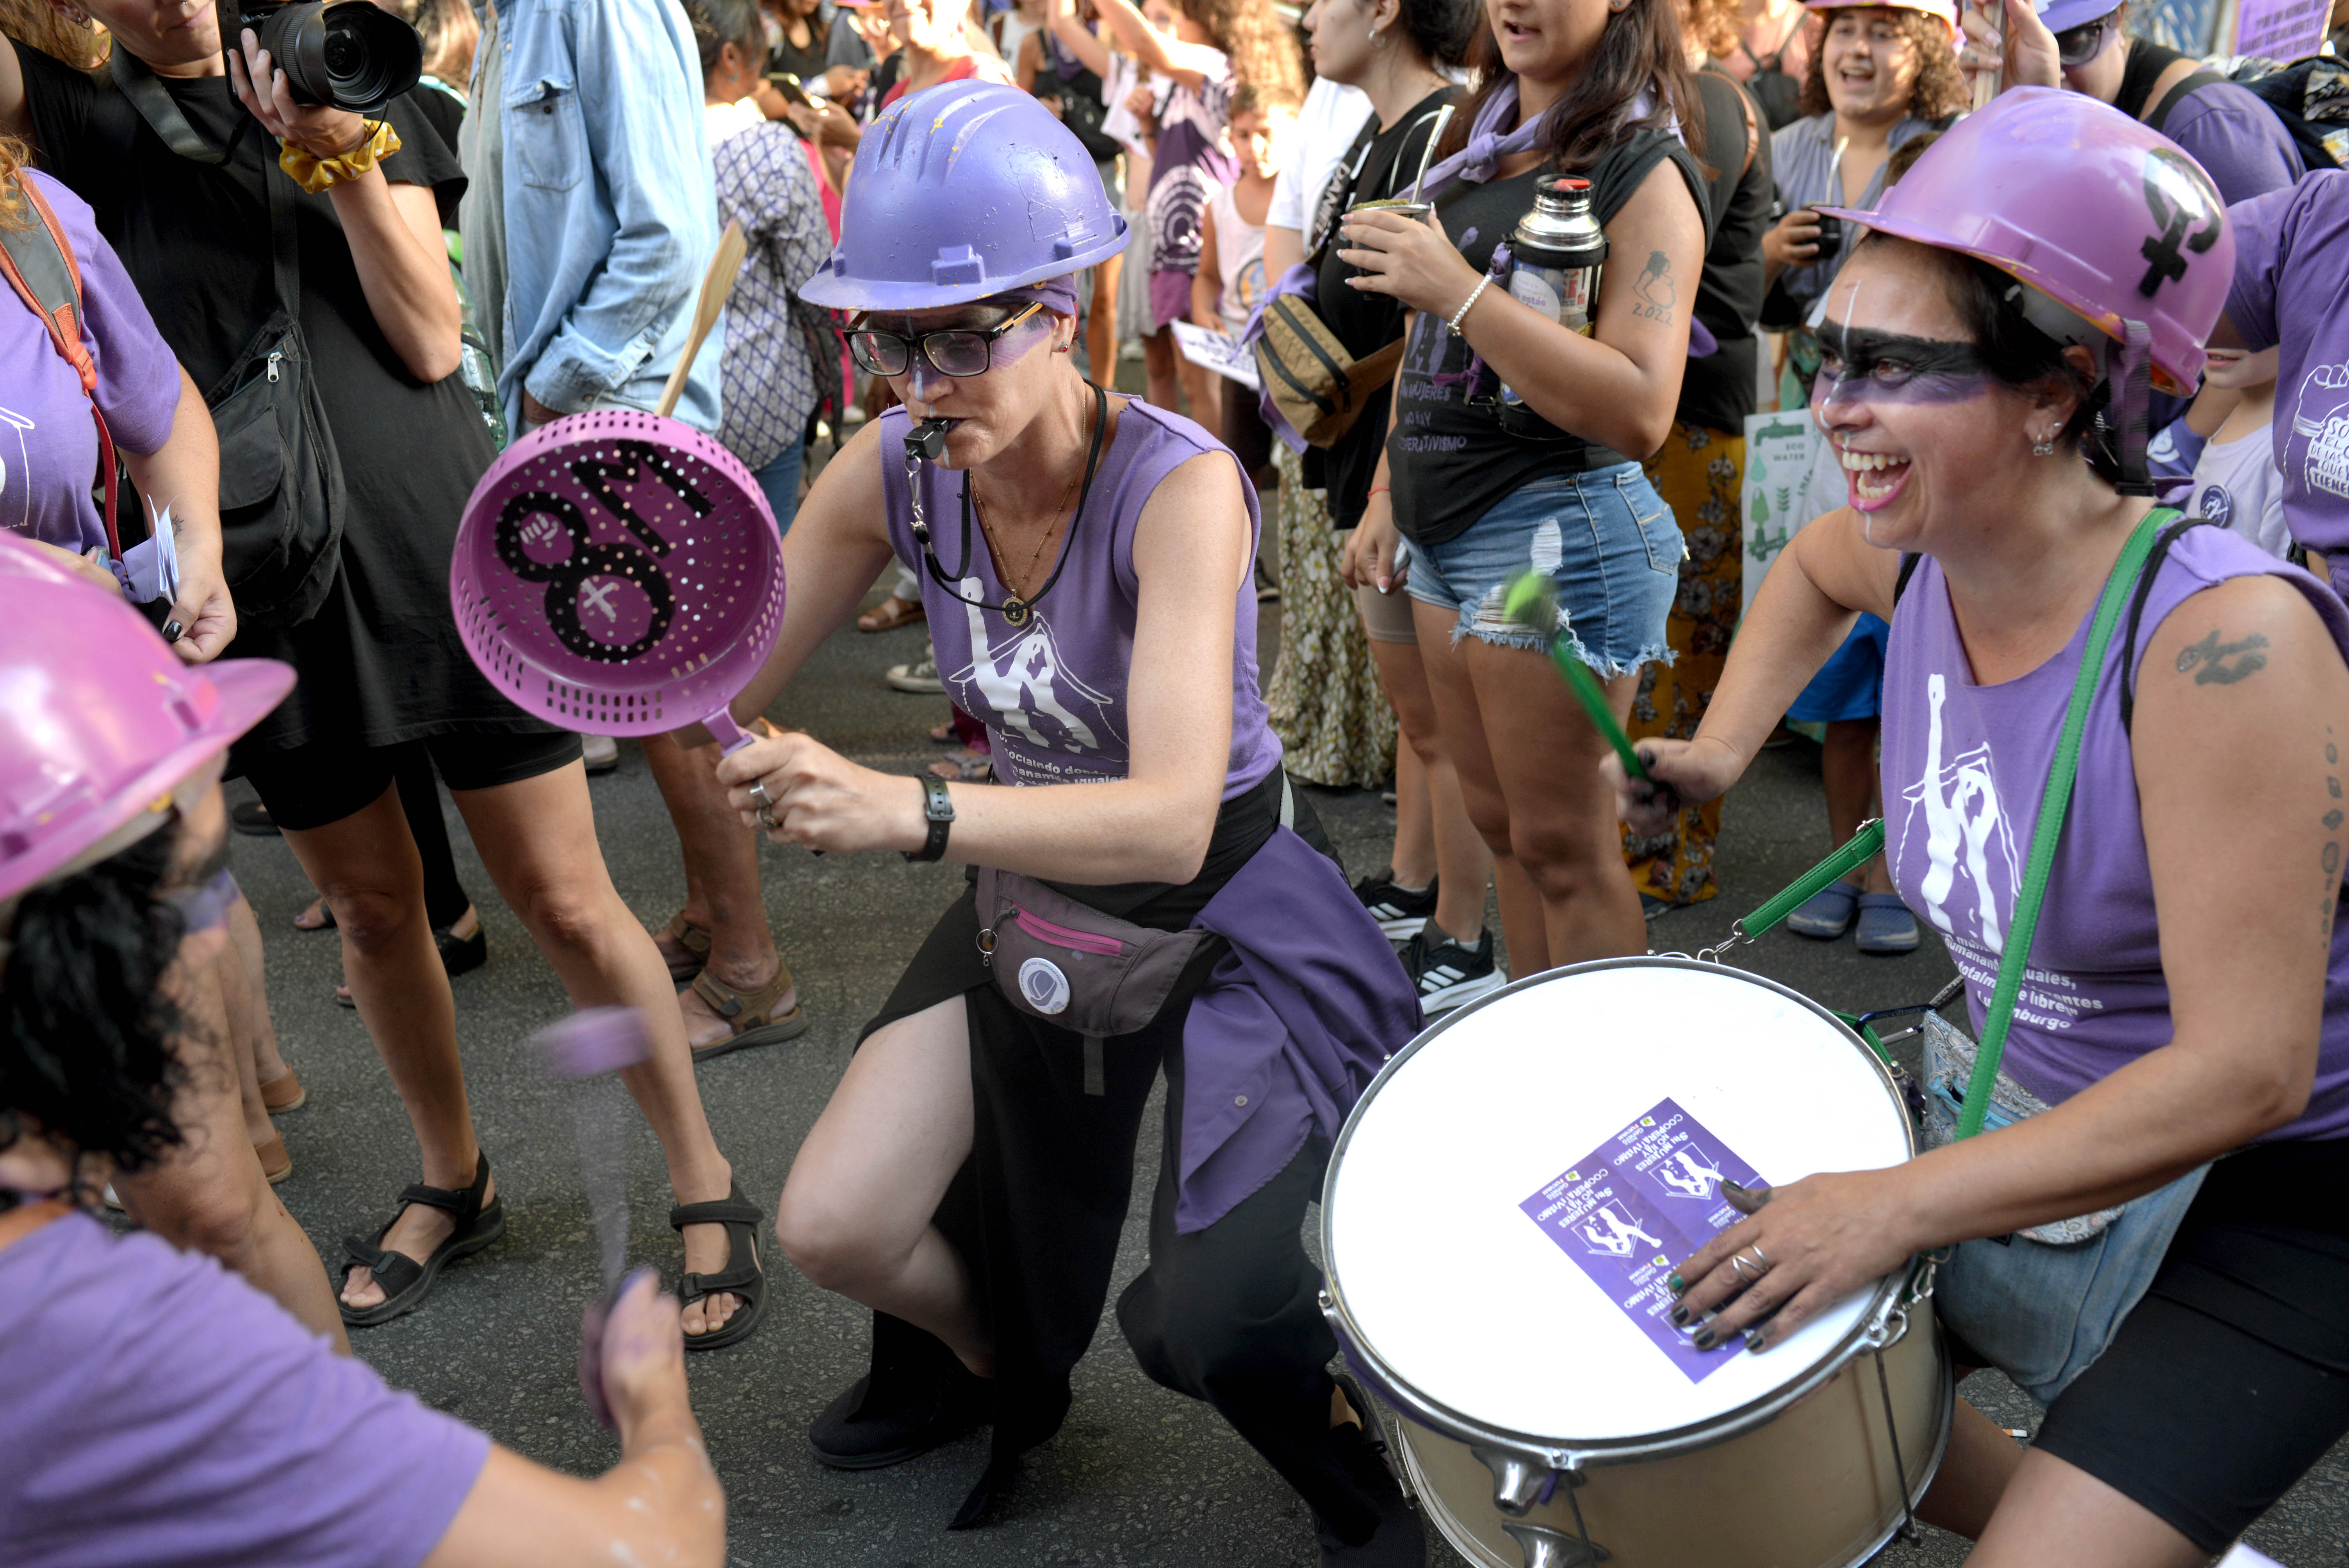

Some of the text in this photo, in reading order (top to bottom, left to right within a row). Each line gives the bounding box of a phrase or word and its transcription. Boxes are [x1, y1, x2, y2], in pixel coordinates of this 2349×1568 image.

[1633, 303, 1674, 327] 2022
[2324, 436, 2342, 449] EL
[1613, 1114, 1683, 1166] COOPERATIVISMO
[1635, 1131, 1688, 1172] SIN MUJERES
[1642, 1133, 1670, 1158] NO HAY
[1537, 1168, 1608, 1221] COOPERATIVISMO
[1558, 1187, 1613, 1228] SIN MUJERES
[1566, 1188, 1594, 1213] NO HAY
